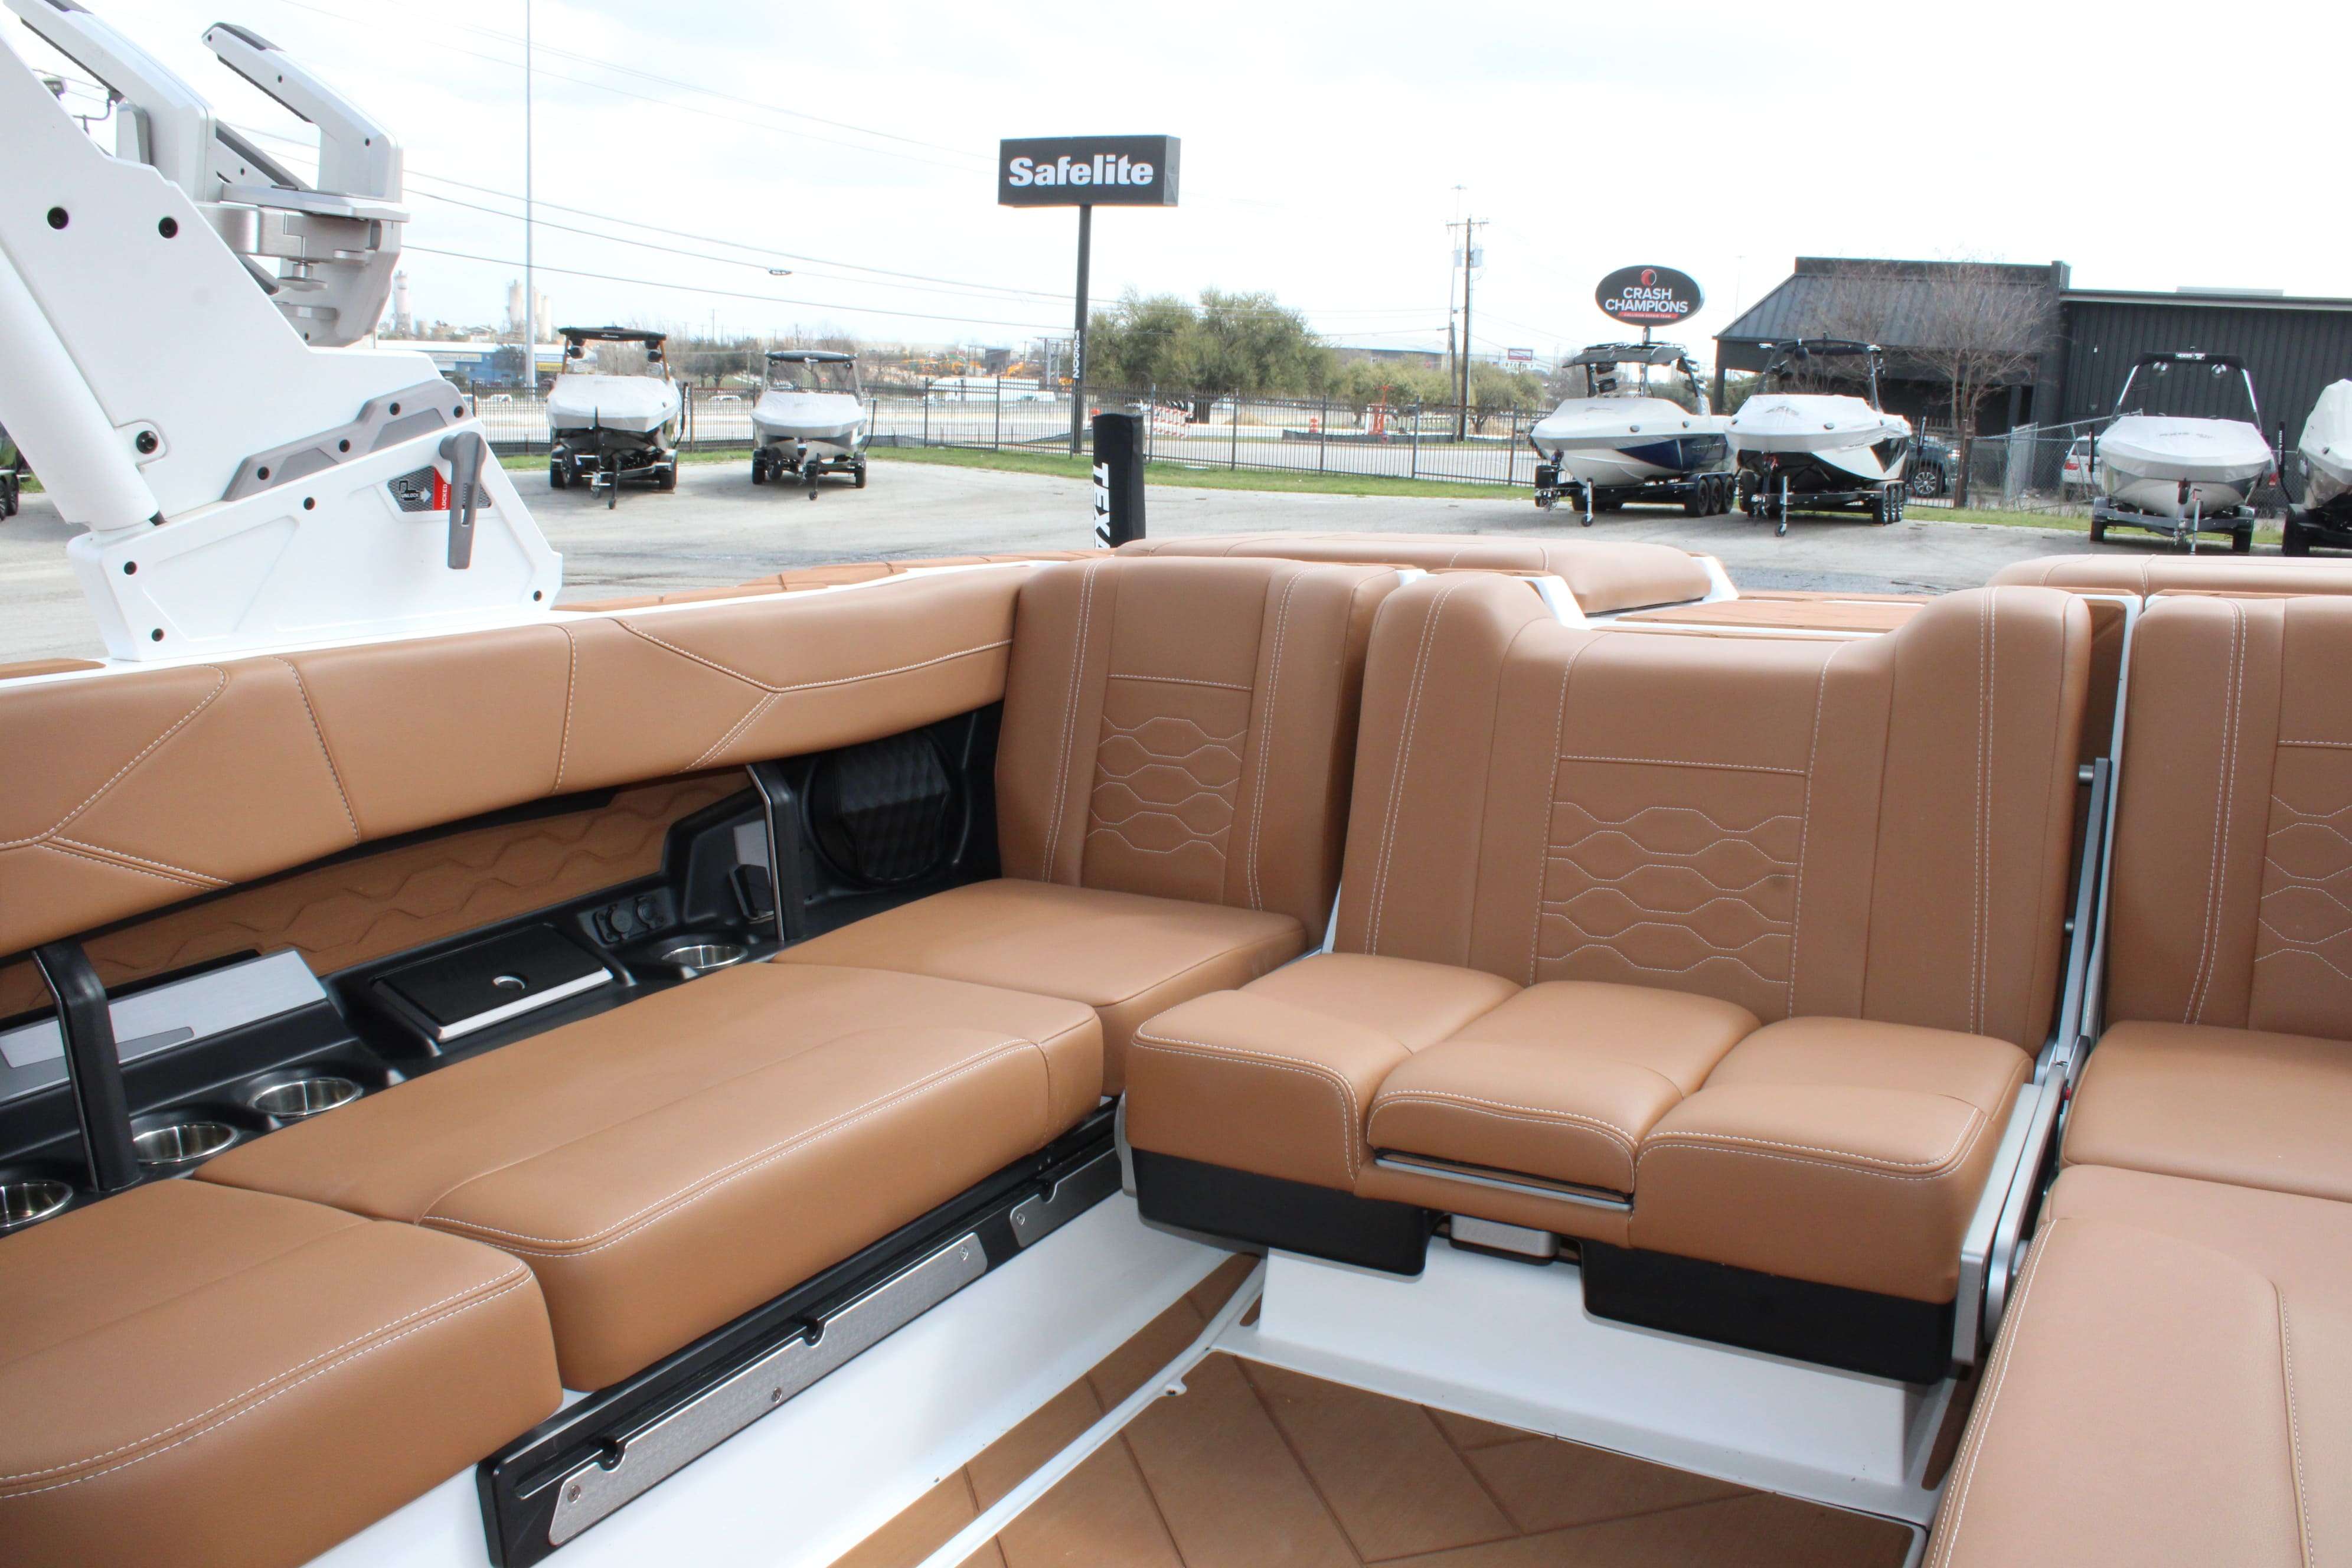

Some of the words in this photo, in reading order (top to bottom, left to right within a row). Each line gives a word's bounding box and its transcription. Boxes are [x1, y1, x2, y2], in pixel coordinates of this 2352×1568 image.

[1009, 153, 1154, 187] Safelite
[1623, 287, 1672, 300] CRASH
[1605, 299, 1688, 313] CHAMPIONS
[1072, 329, 1080, 378] 16602
